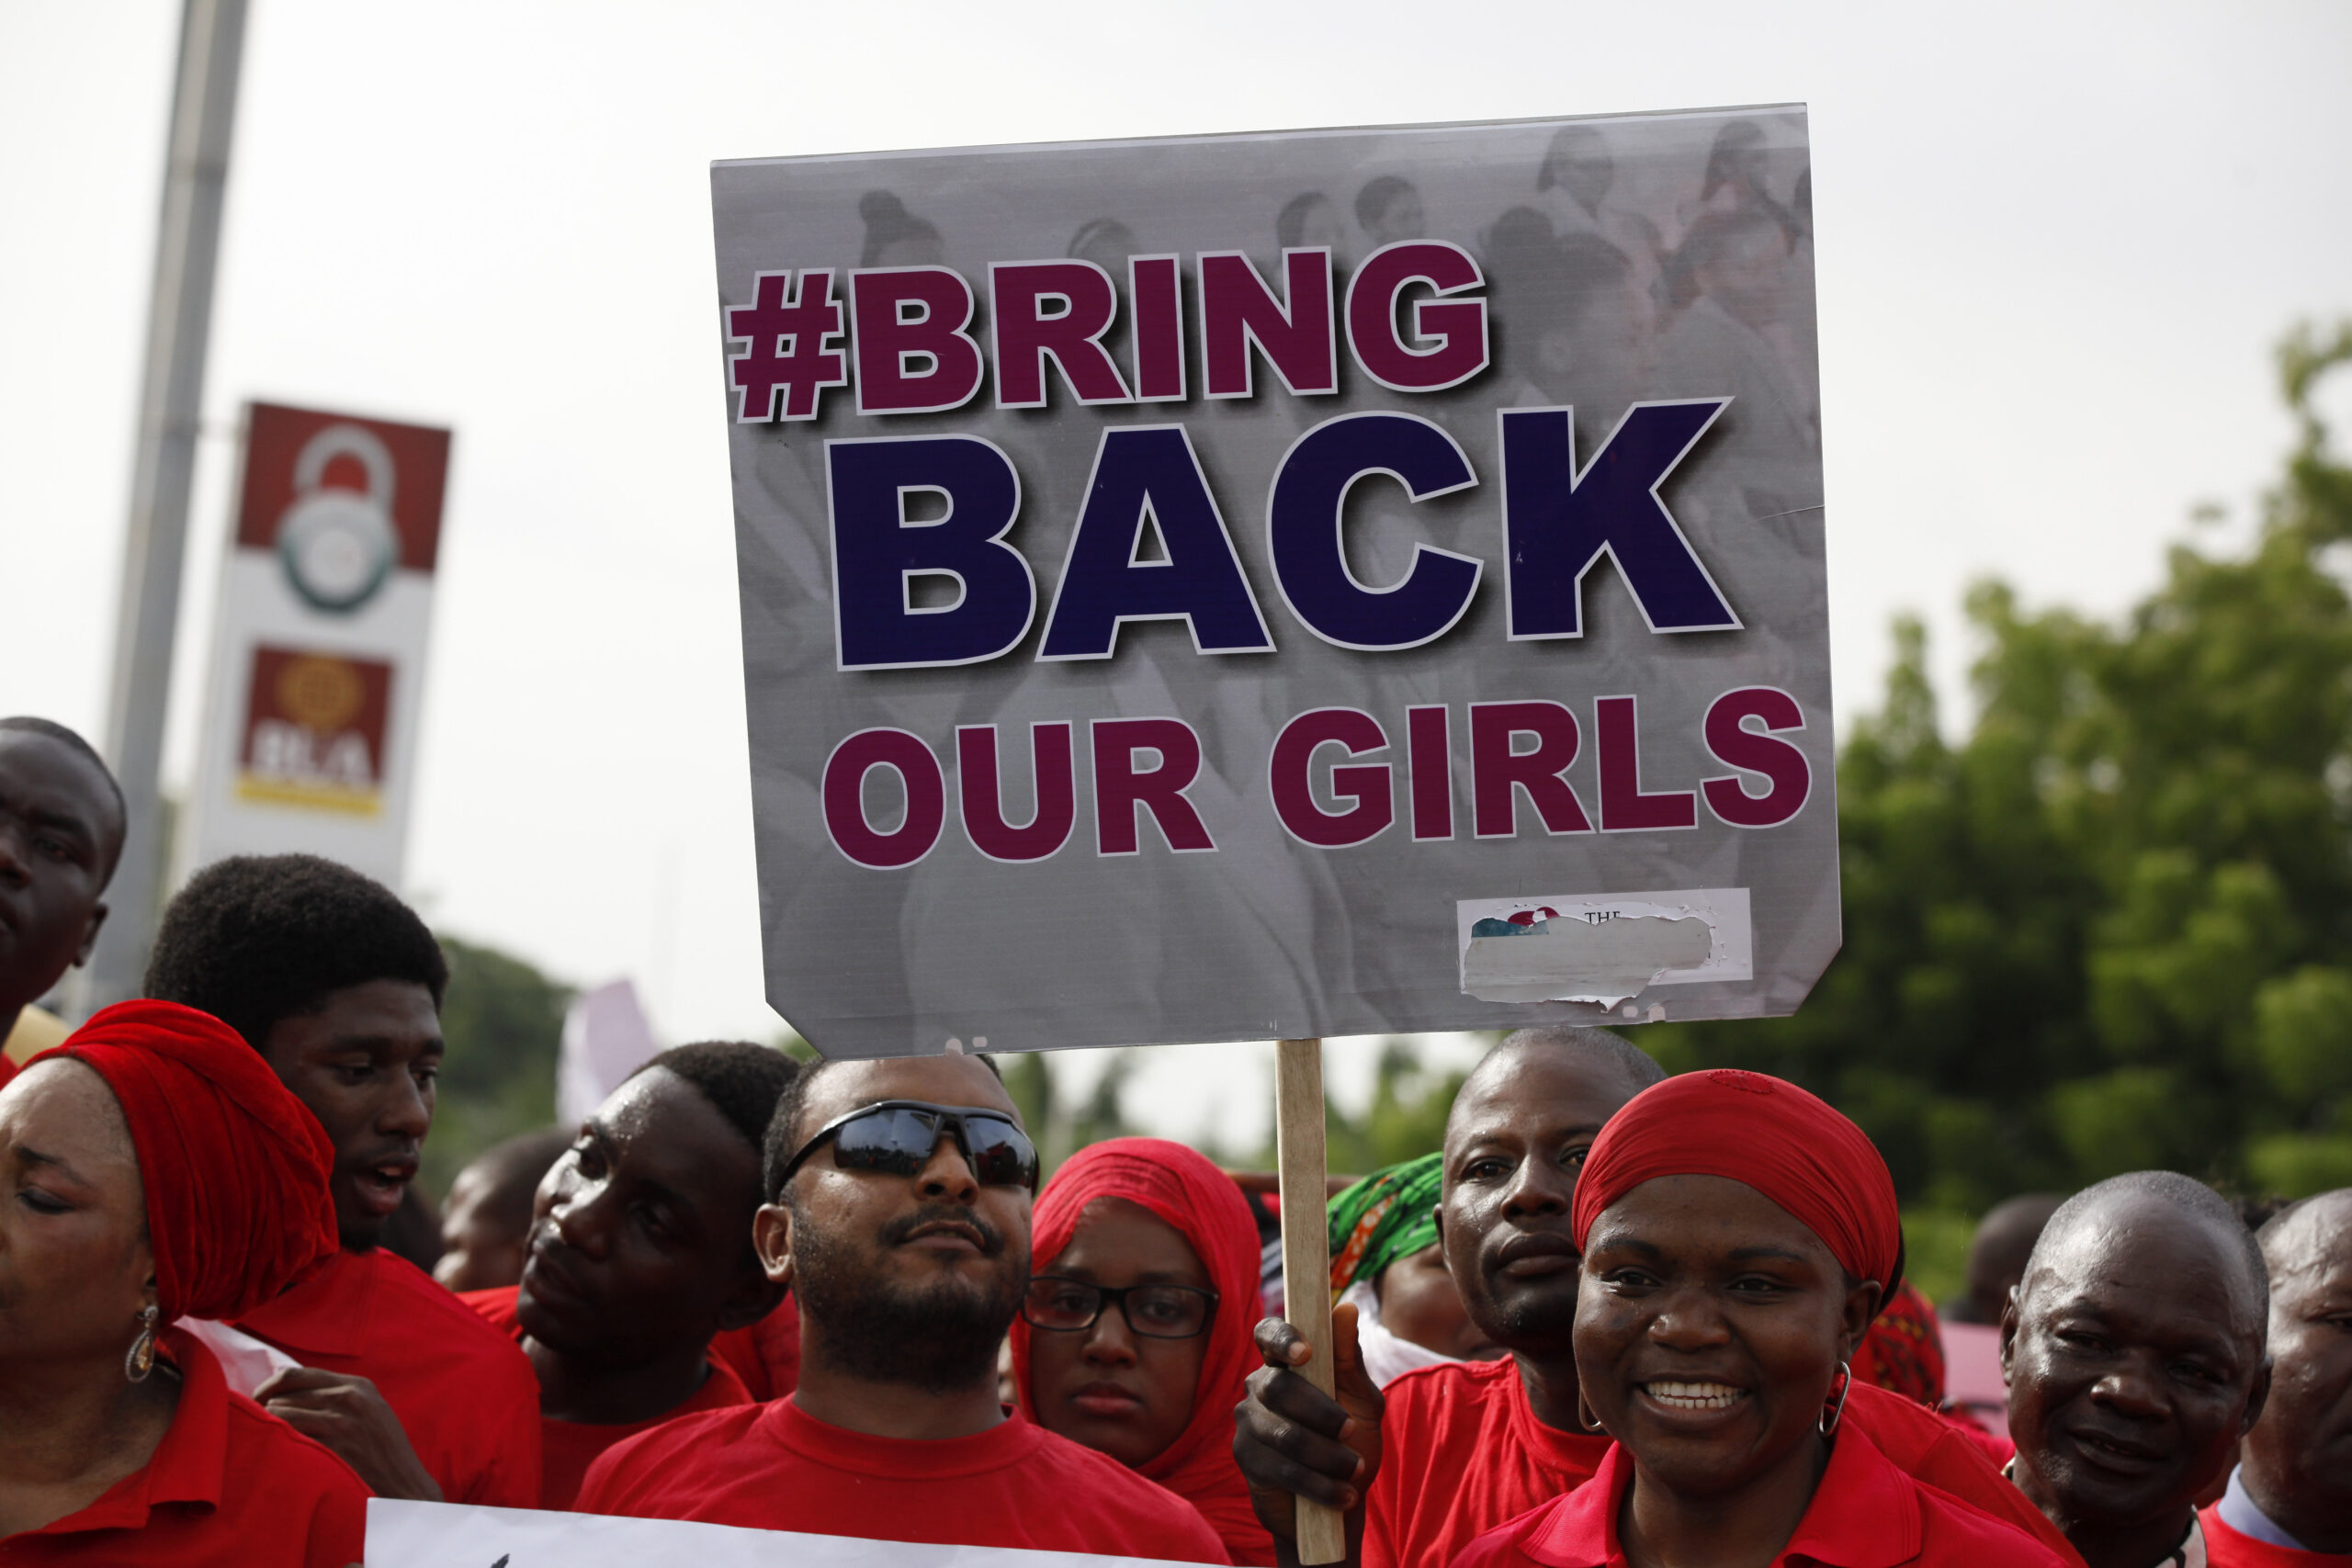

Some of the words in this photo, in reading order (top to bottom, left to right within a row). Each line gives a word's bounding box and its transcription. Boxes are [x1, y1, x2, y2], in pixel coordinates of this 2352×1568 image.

[725, 239, 1489, 423] #BRING
[824, 395, 1745, 671] BACK
[820, 716, 1219, 870] OUR
[1268, 684, 1812, 850] GIRLS
